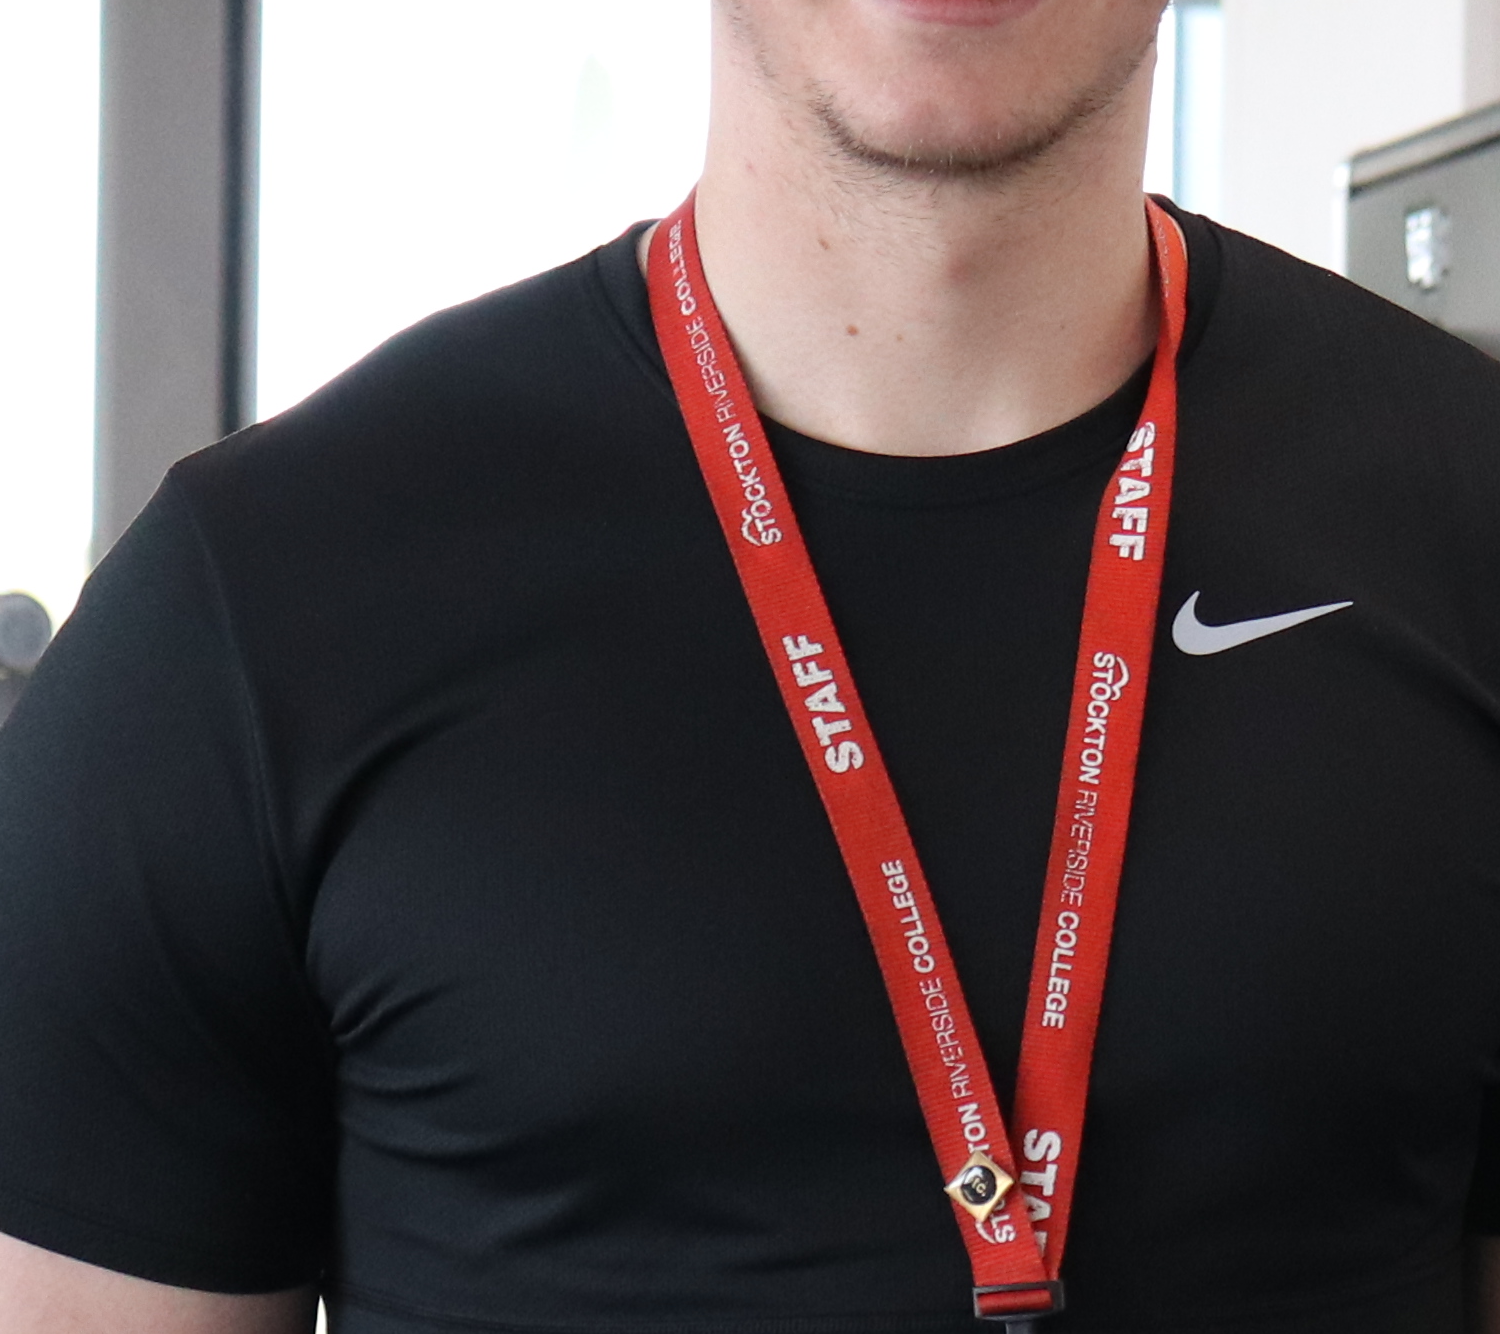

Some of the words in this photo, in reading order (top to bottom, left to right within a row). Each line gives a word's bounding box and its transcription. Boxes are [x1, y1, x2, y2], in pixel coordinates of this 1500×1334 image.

[668, 219, 697, 316] COLLEGE
[685, 316, 736, 423] RIVERSIDE
[723, 423, 783, 546] STOCKTON
[1108, 421, 1156, 561] STAFF
[782, 634, 865, 774] STAFF
[1078, 651, 1116, 785] STOCKTON
[1060, 788, 1098, 907] RIVERSIDE
[881, 859, 935, 974] COLLEGE
[1041, 911, 1080, 1029] COLLEGE
[919, 977, 973, 1099] RIVERSIDE
[958, 1102, 1016, 1244] STTON
